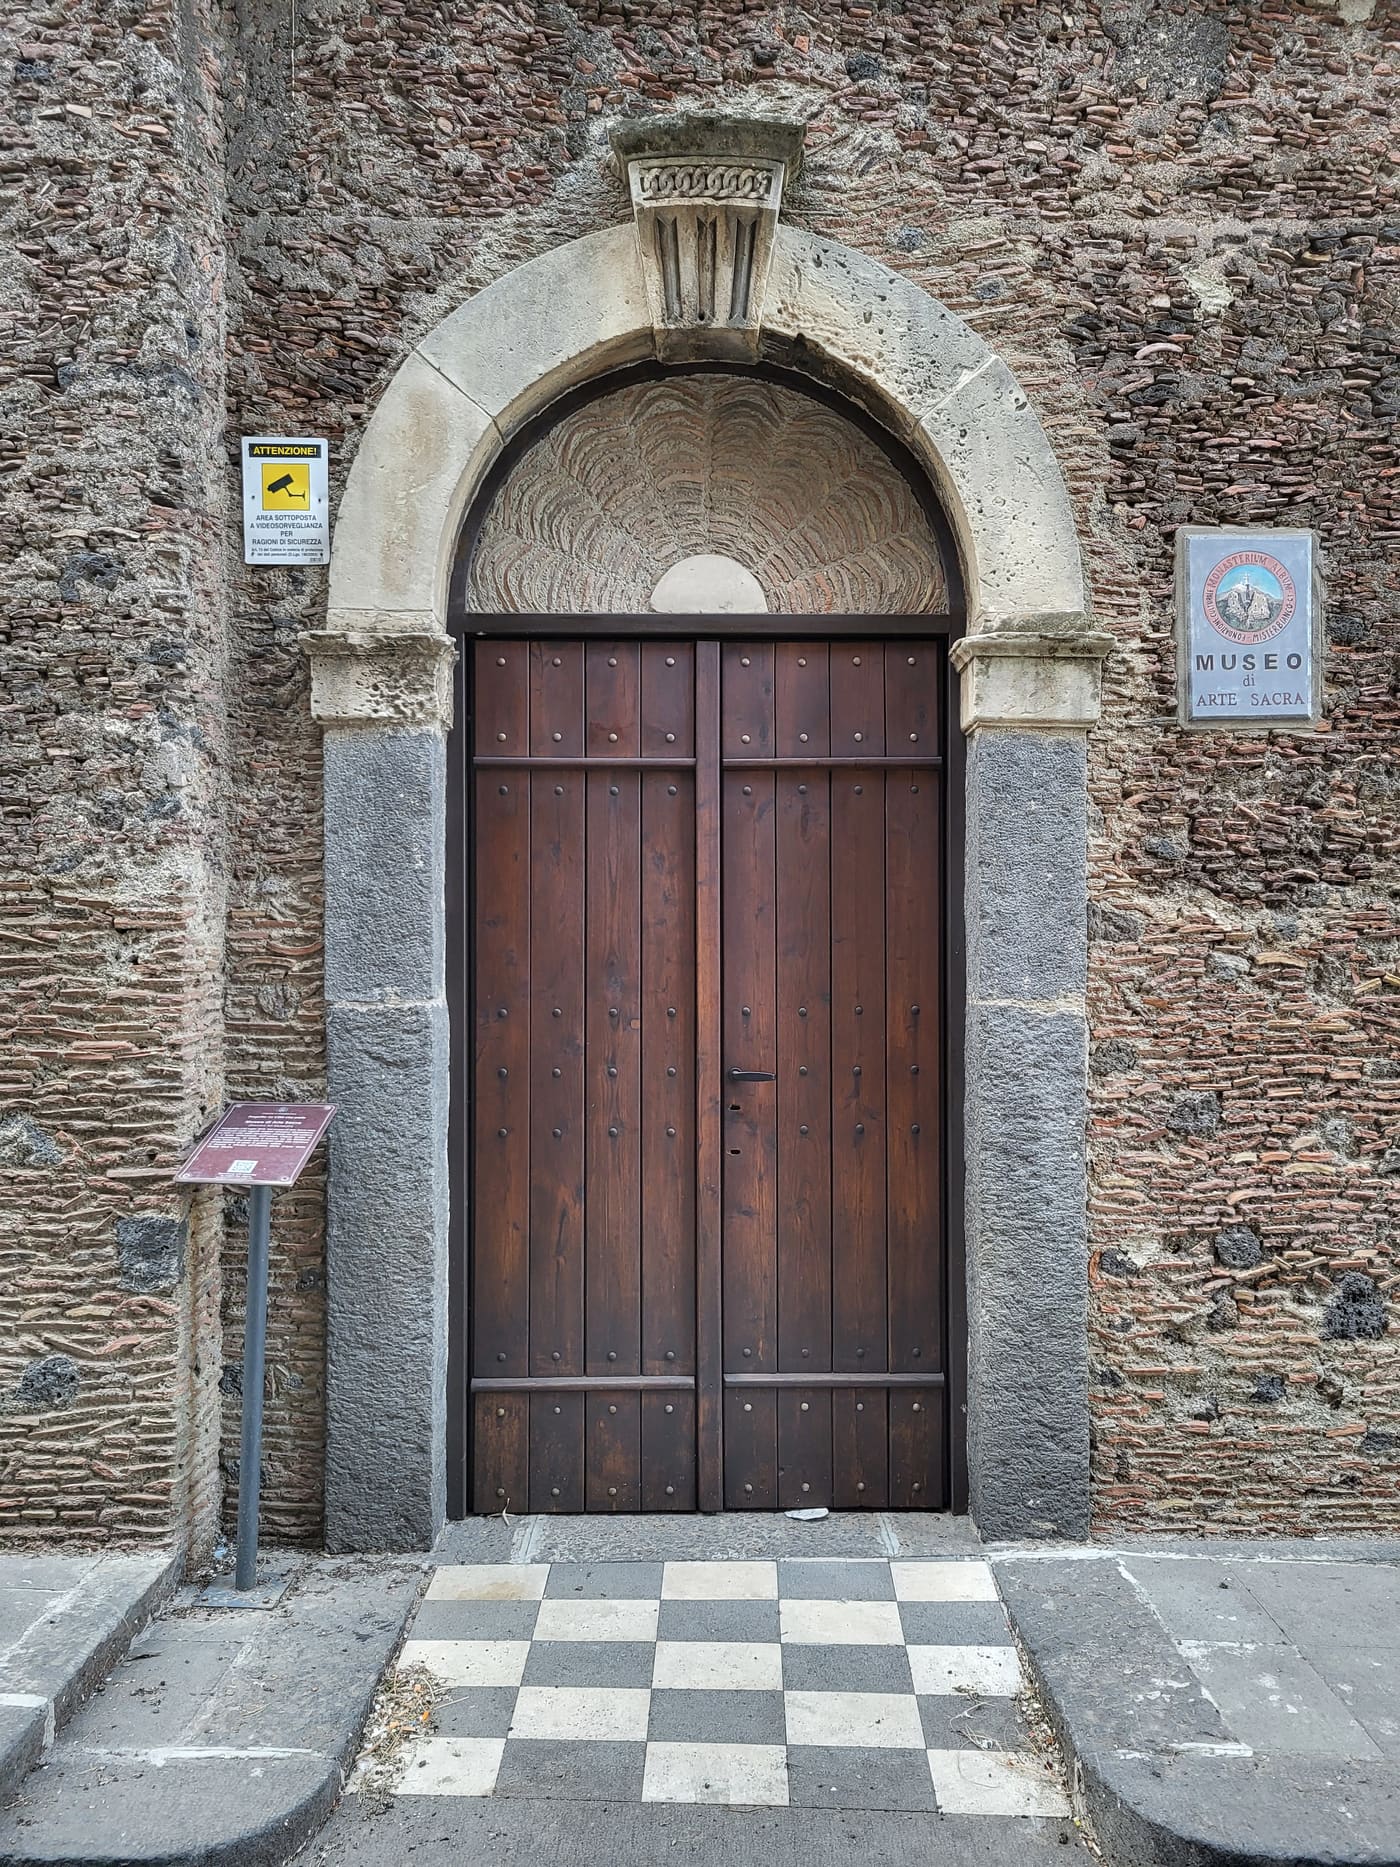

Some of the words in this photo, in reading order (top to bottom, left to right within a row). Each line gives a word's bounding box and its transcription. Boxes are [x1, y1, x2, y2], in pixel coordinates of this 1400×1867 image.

[253, 446, 317, 456] ATTENZIONE!
[1207, 553, 1269, 588] MONASTERIUM
[1196, 653, 1302, 671] MUSEO
[1242, 674, 1256, 687] di
[1196, 693, 1238, 707] ARTE
[1251, 692, 1306, 707] SACRA
